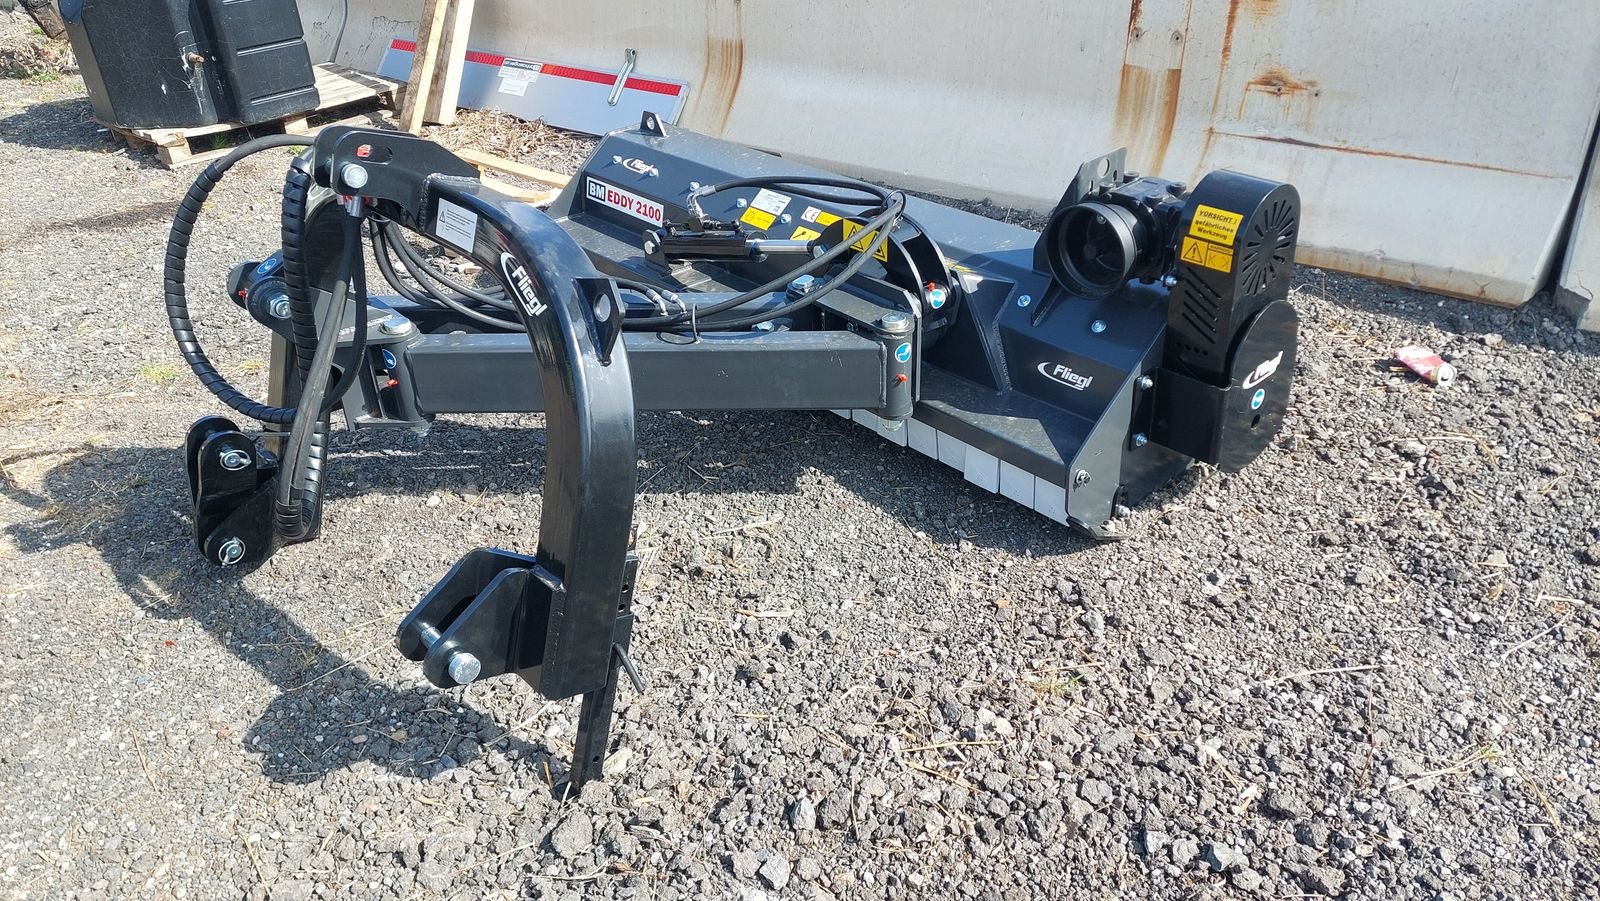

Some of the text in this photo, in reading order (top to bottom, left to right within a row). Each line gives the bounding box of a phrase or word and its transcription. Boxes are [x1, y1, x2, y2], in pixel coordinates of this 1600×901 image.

[589, 182, 661, 221] BM EDDY 2100
[1195, 219, 1234, 234] gefährliches
[1199, 209, 1233, 224] VORSICHT
[1197, 226, 1228, 240] Werkzeug
[511, 265, 548, 317] Fliegl
[1052, 363, 1094, 389] Fliegl
